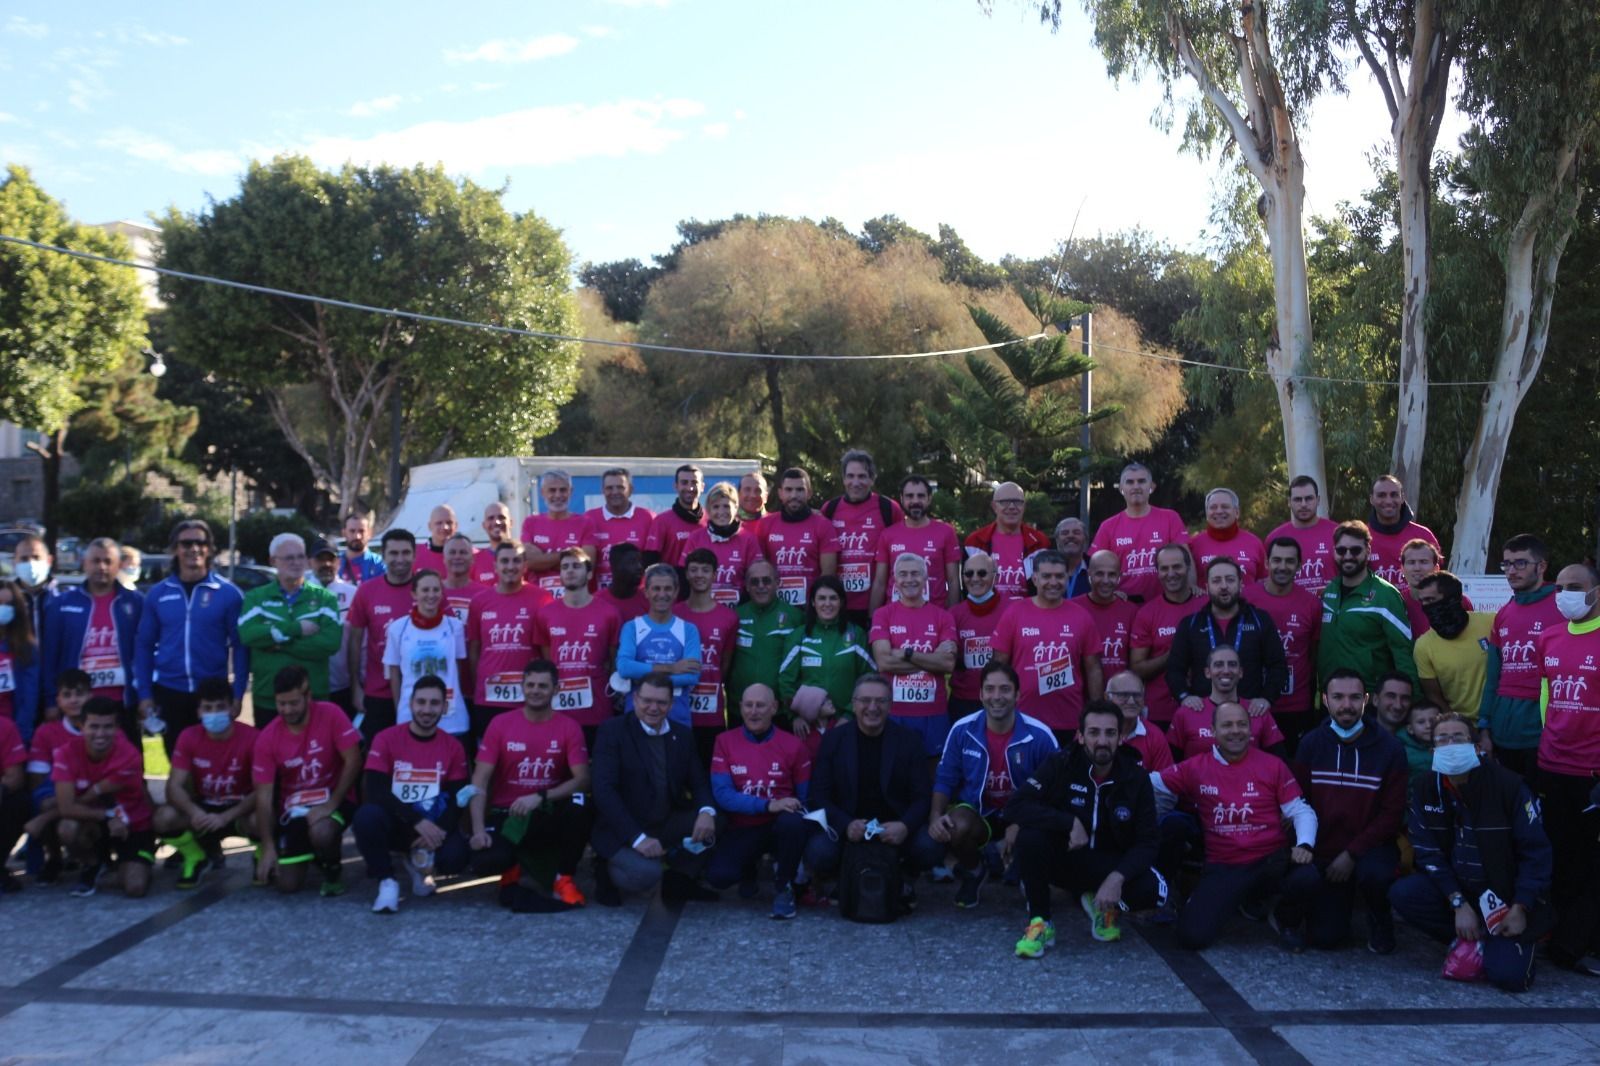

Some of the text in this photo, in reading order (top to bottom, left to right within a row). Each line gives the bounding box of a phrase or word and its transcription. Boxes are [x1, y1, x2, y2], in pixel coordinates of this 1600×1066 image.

[844, 579, 865, 591] 059
[777, 590, 799, 603] 802
[1046, 671, 1068, 690] 982
[494, 686, 517, 700] 961
[559, 692, 583, 707] 861
[902, 688, 929, 701] 1063
[402, 784, 429, 800] 857
